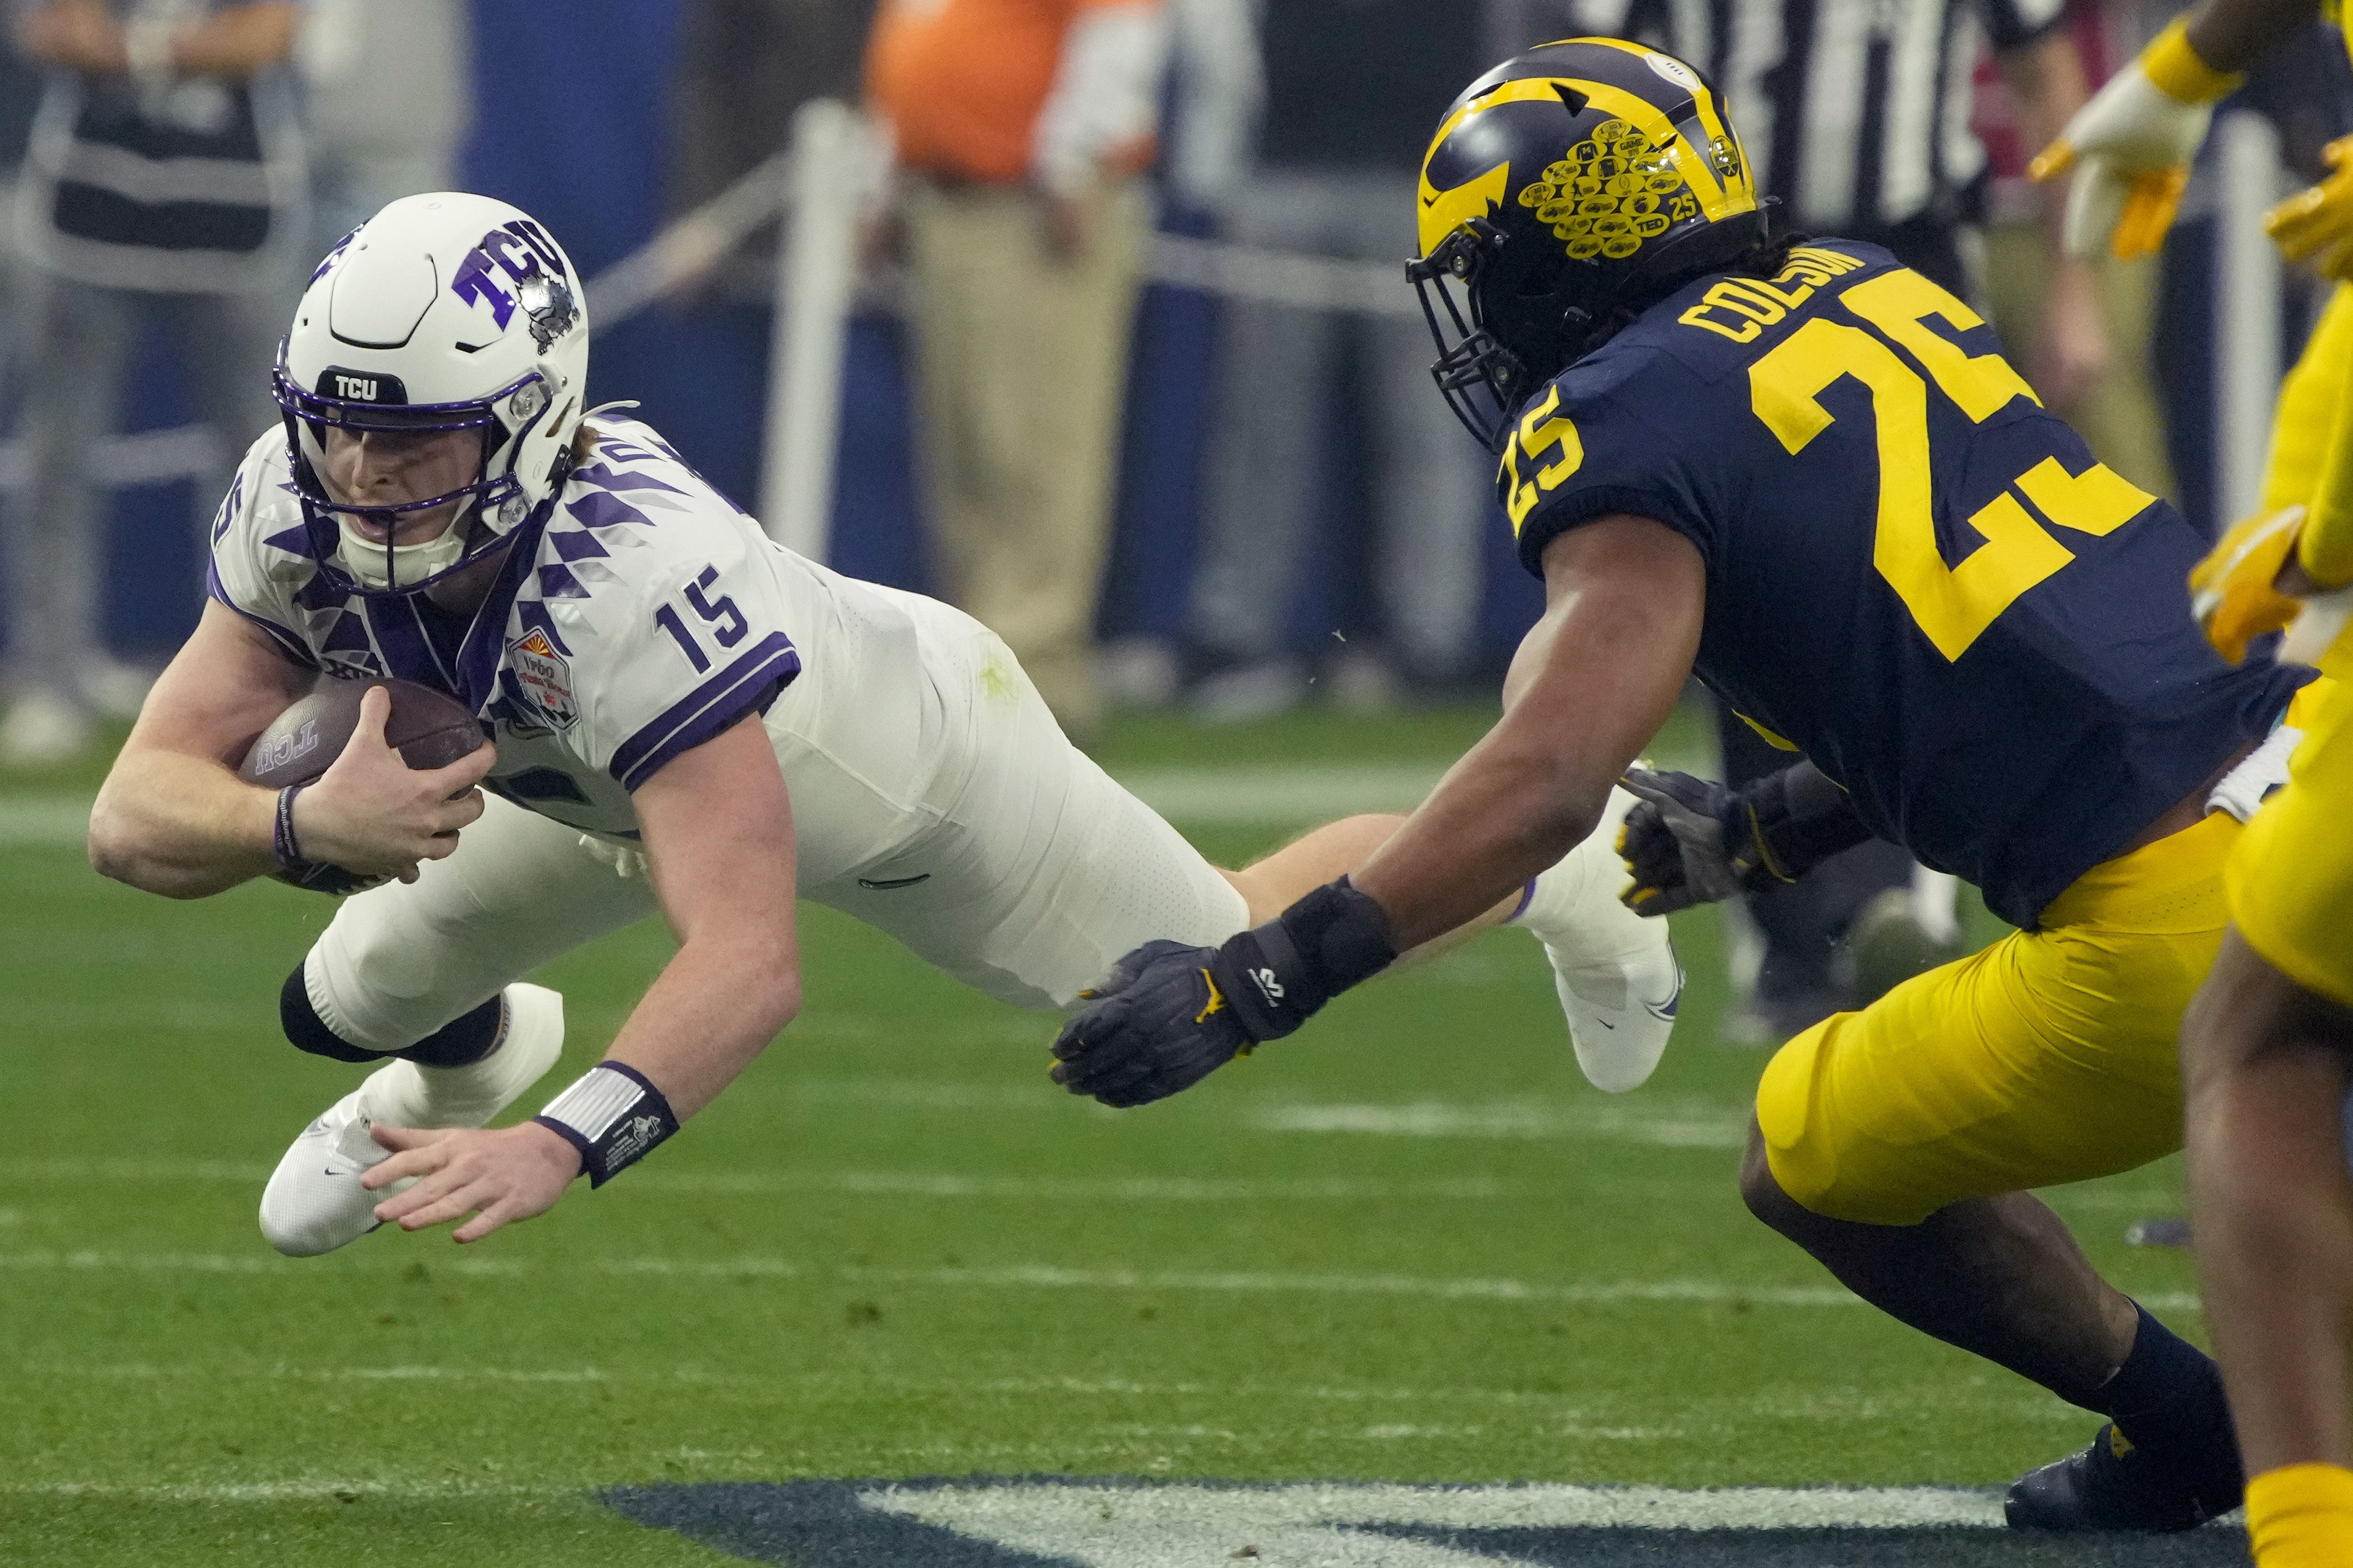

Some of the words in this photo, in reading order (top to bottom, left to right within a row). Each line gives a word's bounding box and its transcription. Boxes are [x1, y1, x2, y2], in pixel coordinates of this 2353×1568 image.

[1669, 192, 1696, 222] 25
[451, 220, 567, 332] TCU
[1678, 247, 1866, 343] COLSON
[335, 375, 377, 401] TCU
[1749, 267, 2159, 663] 25
[654, 564, 749, 676] 15
[255, 719, 318, 776] TCU
